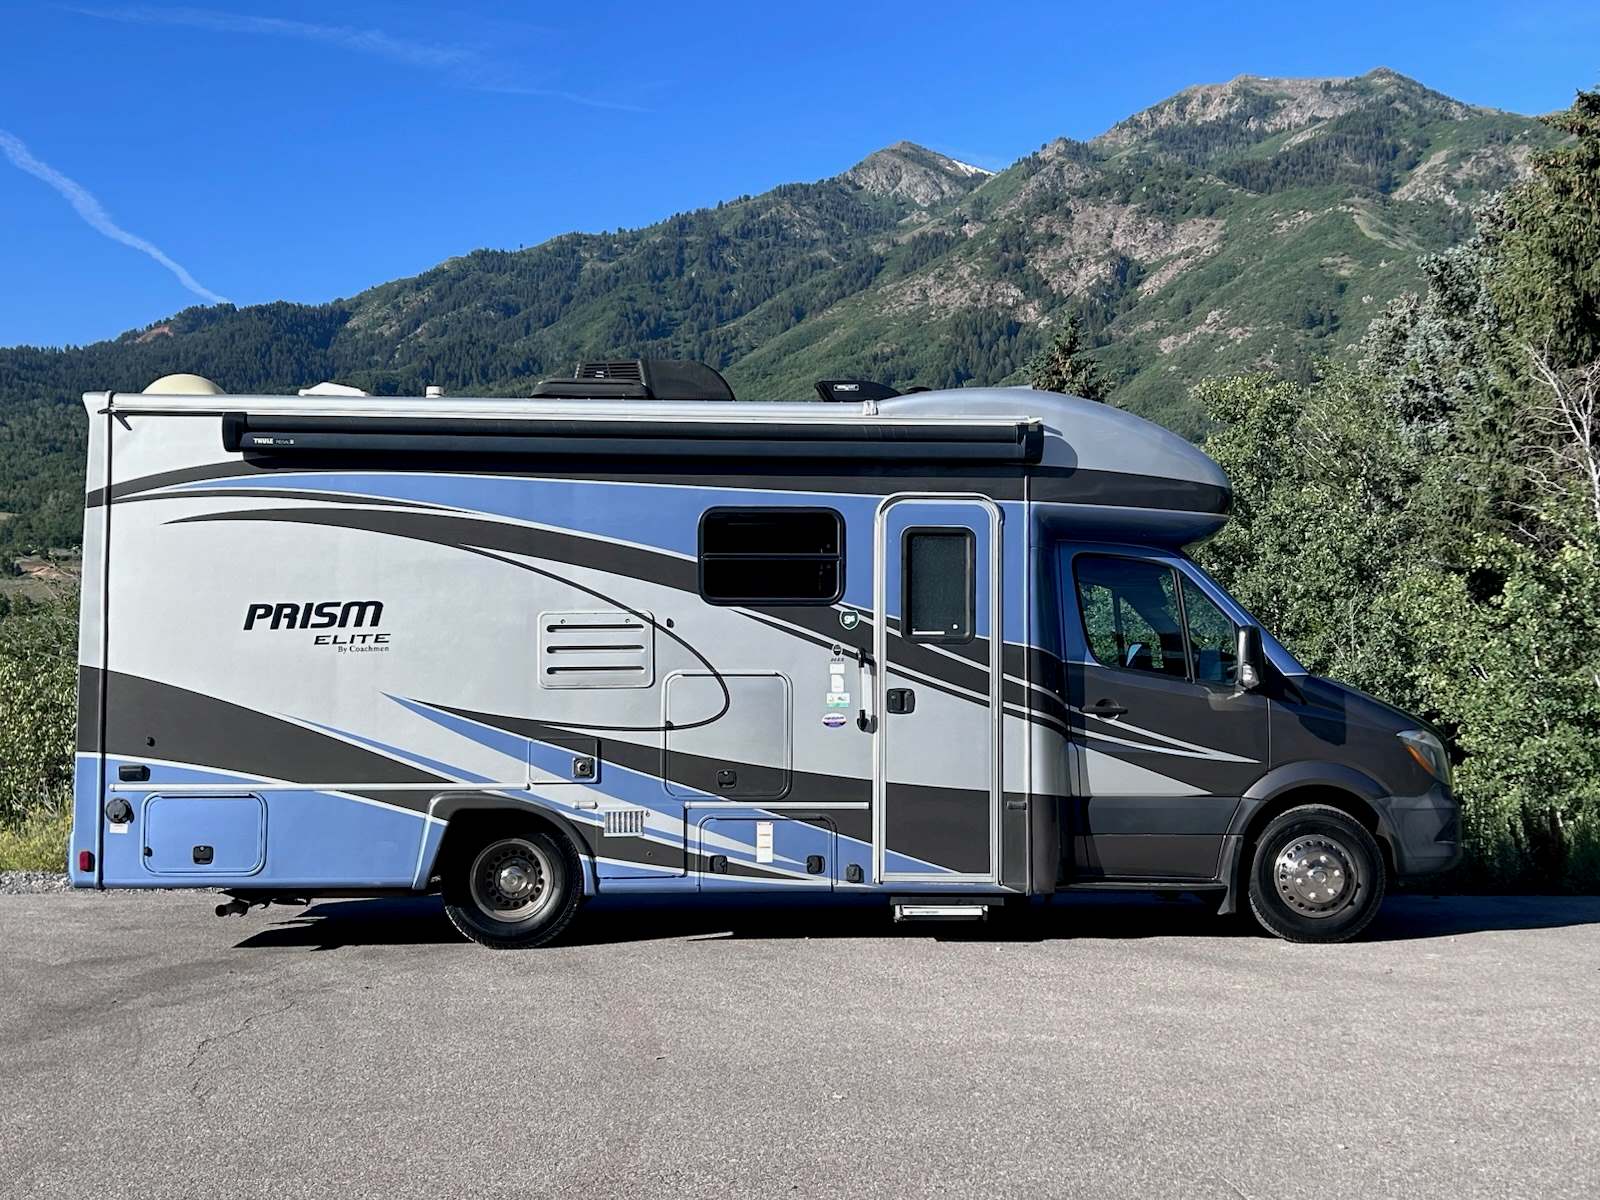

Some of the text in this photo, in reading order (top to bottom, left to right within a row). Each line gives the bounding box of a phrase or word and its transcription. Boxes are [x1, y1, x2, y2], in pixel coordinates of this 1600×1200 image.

[243, 601, 384, 630] PRISM
[314, 633, 391, 645] ELITE
[338, 646, 347, 654] By
